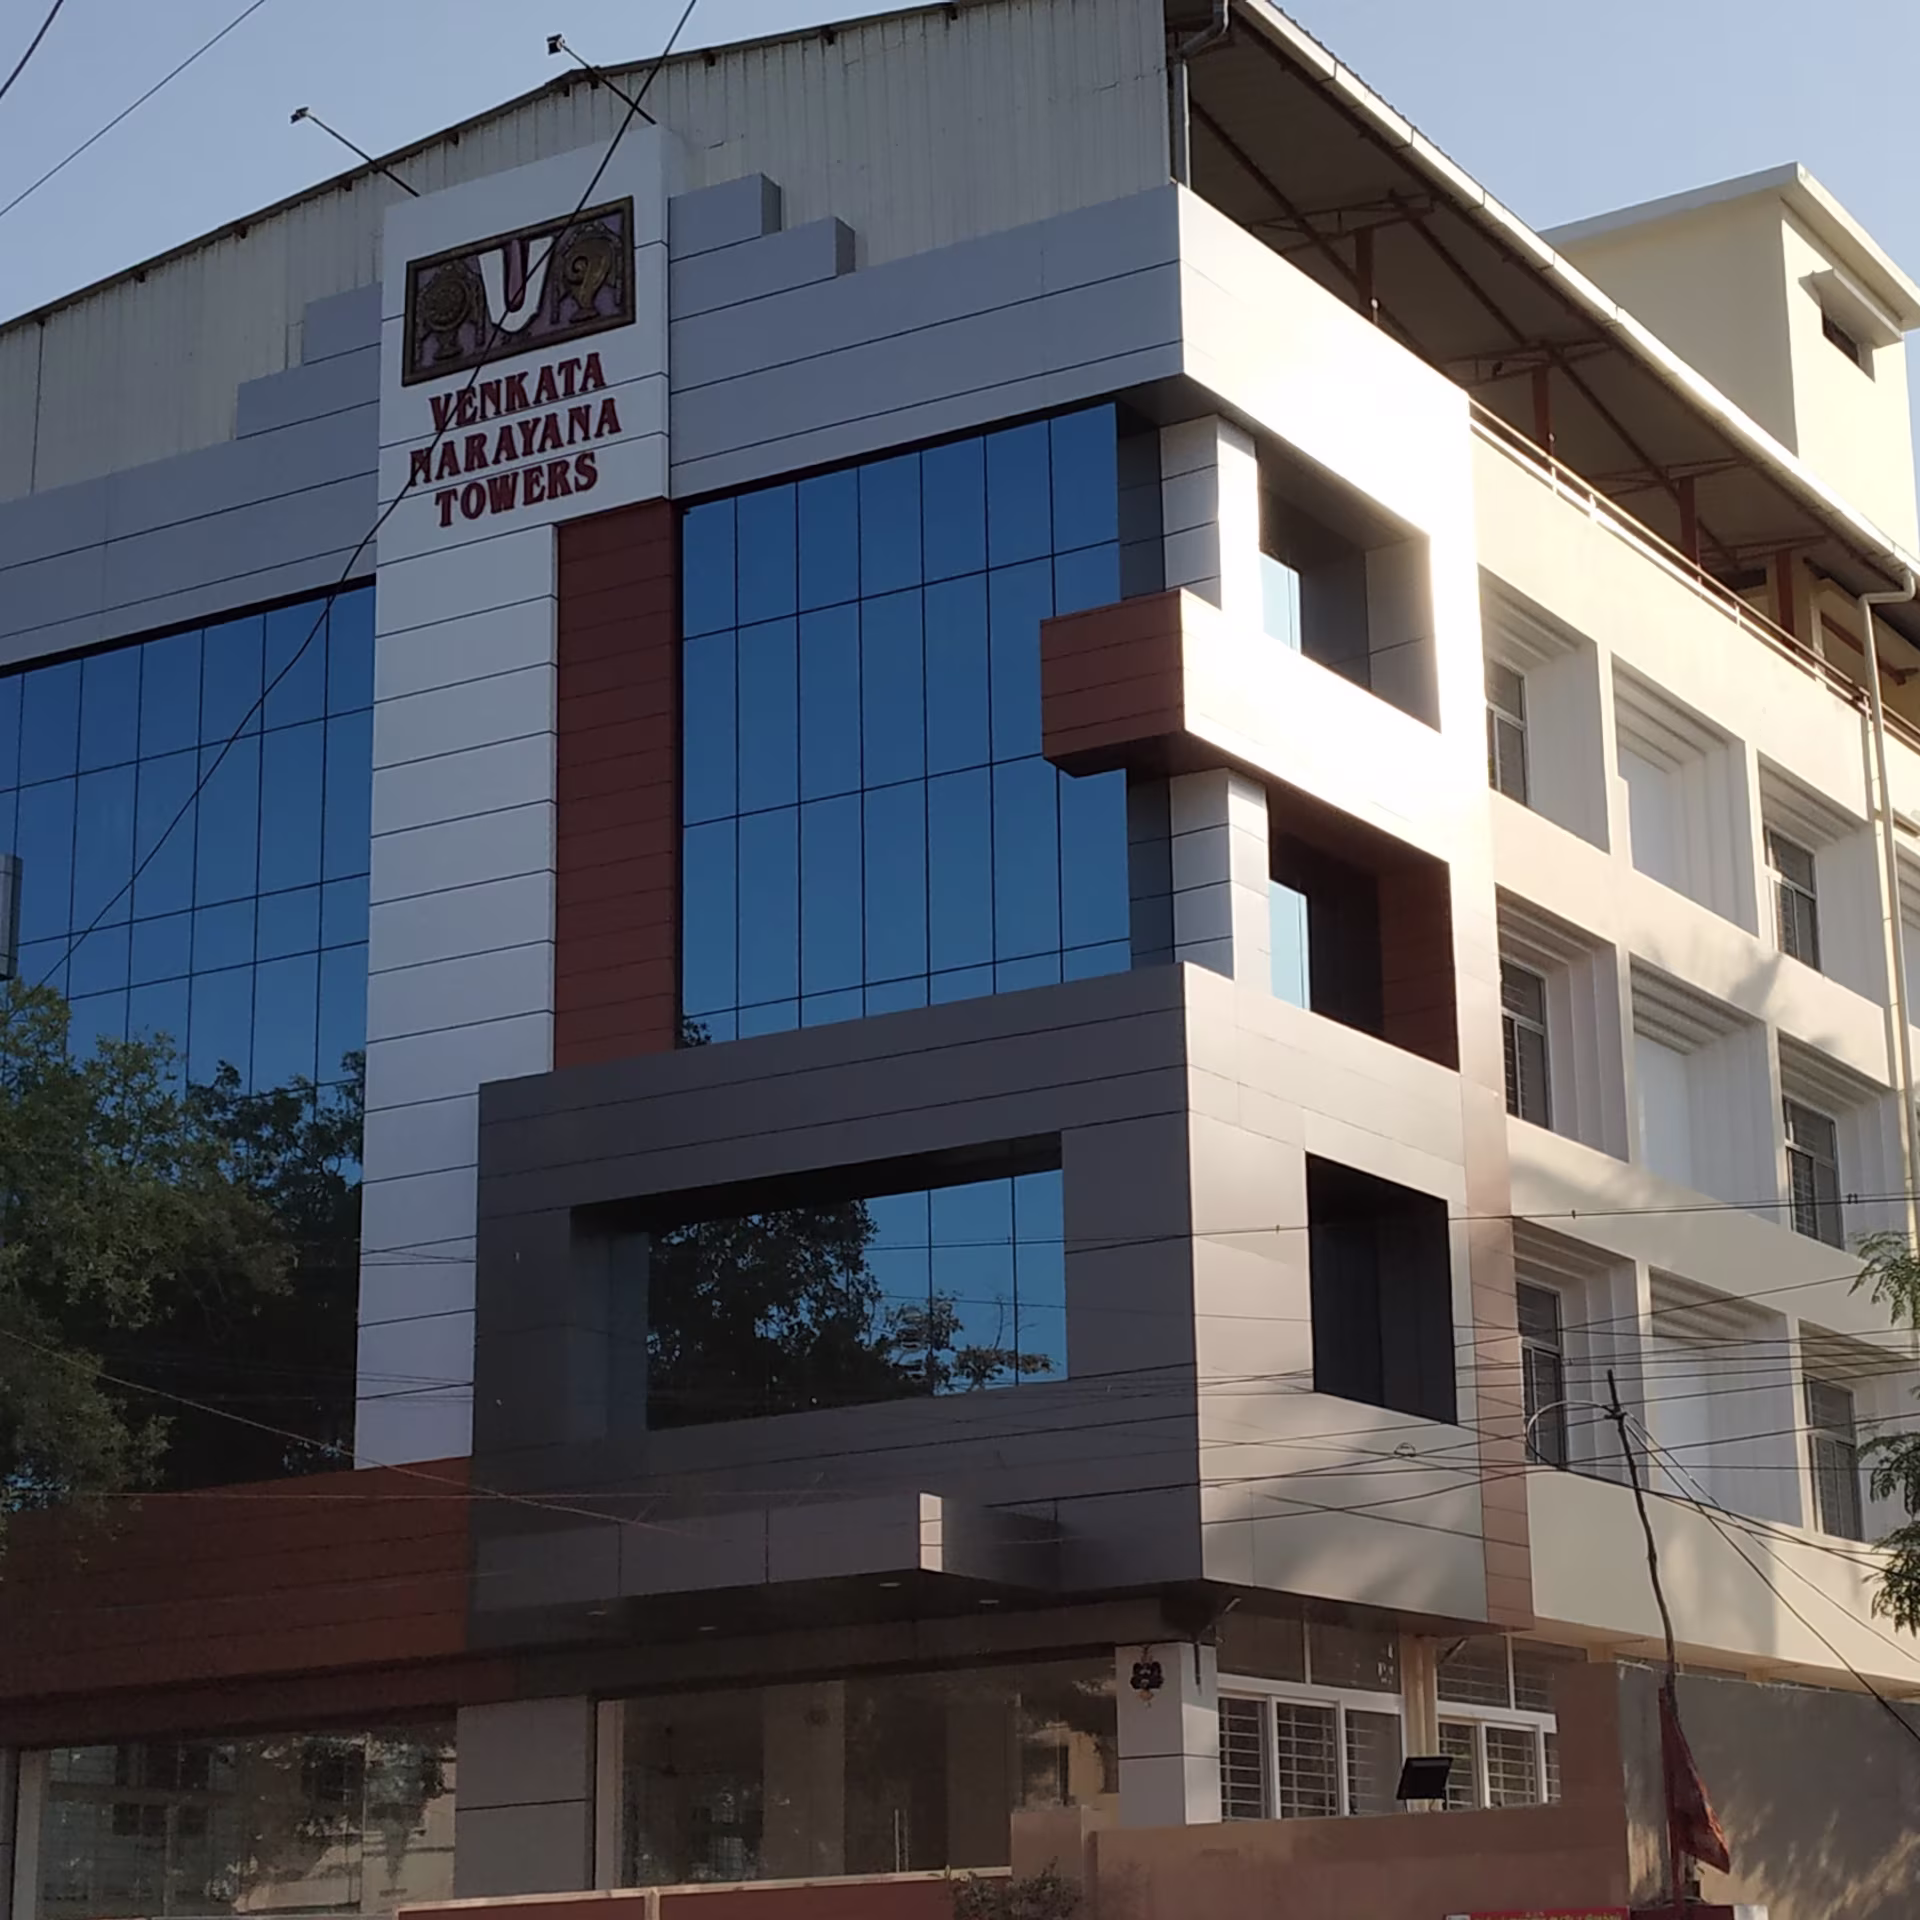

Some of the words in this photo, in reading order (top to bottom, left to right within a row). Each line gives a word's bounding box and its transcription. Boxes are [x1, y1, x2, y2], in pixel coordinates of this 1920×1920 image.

[429, 352, 606, 432] VENKATA
[410, 398, 622, 486] NARAYANA
[435, 452, 598, 528] TOWERS
